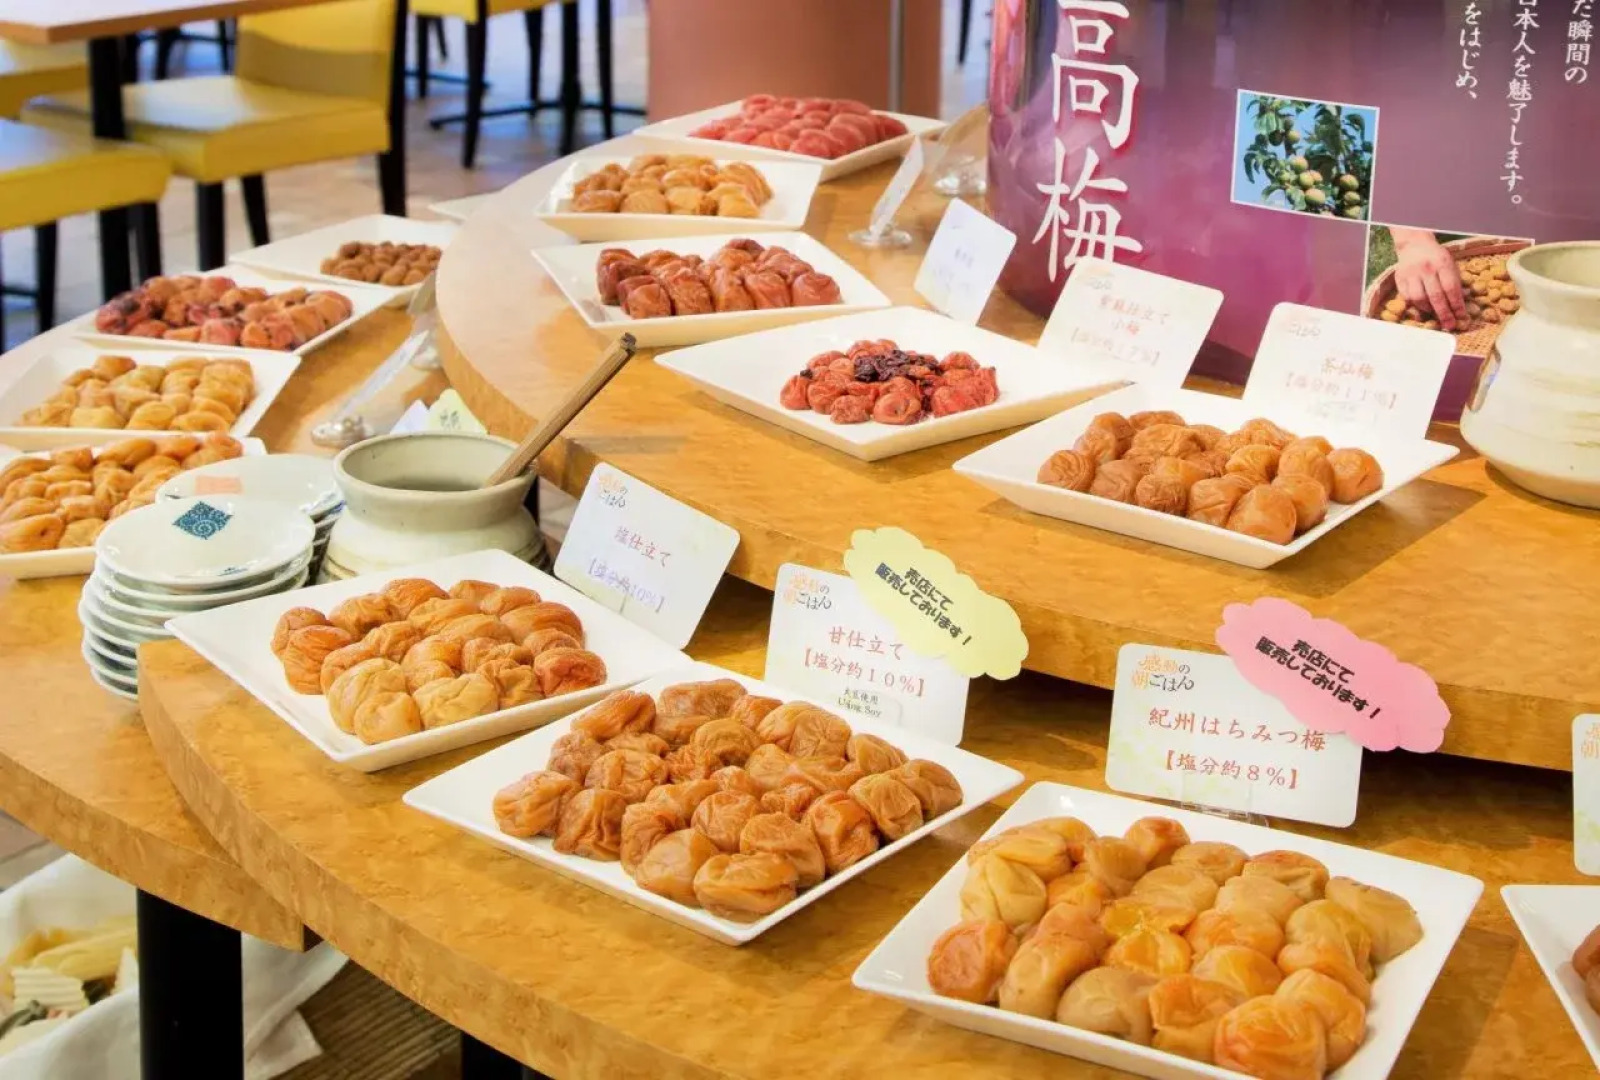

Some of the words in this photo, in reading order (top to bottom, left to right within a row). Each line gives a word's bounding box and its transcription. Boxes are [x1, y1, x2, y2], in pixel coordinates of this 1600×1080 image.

[1455, 2, 1482, 99] をはじめ、
[874, 561, 973, 646] 販売しております!
[904, 566, 954, 612] 売店にて
[828, 626, 905, 661] 甘仕立て
[1291, 638, 1356, 684] 売店にて
[803, 646, 927, 698] 【塩分約10%】
[1254, 635, 1382, 720] 販売しております!
[1149, 707, 1327, 752] 紀州はちみつ梅
[1164, 749, 1299, 790] 【塩分約8%】
